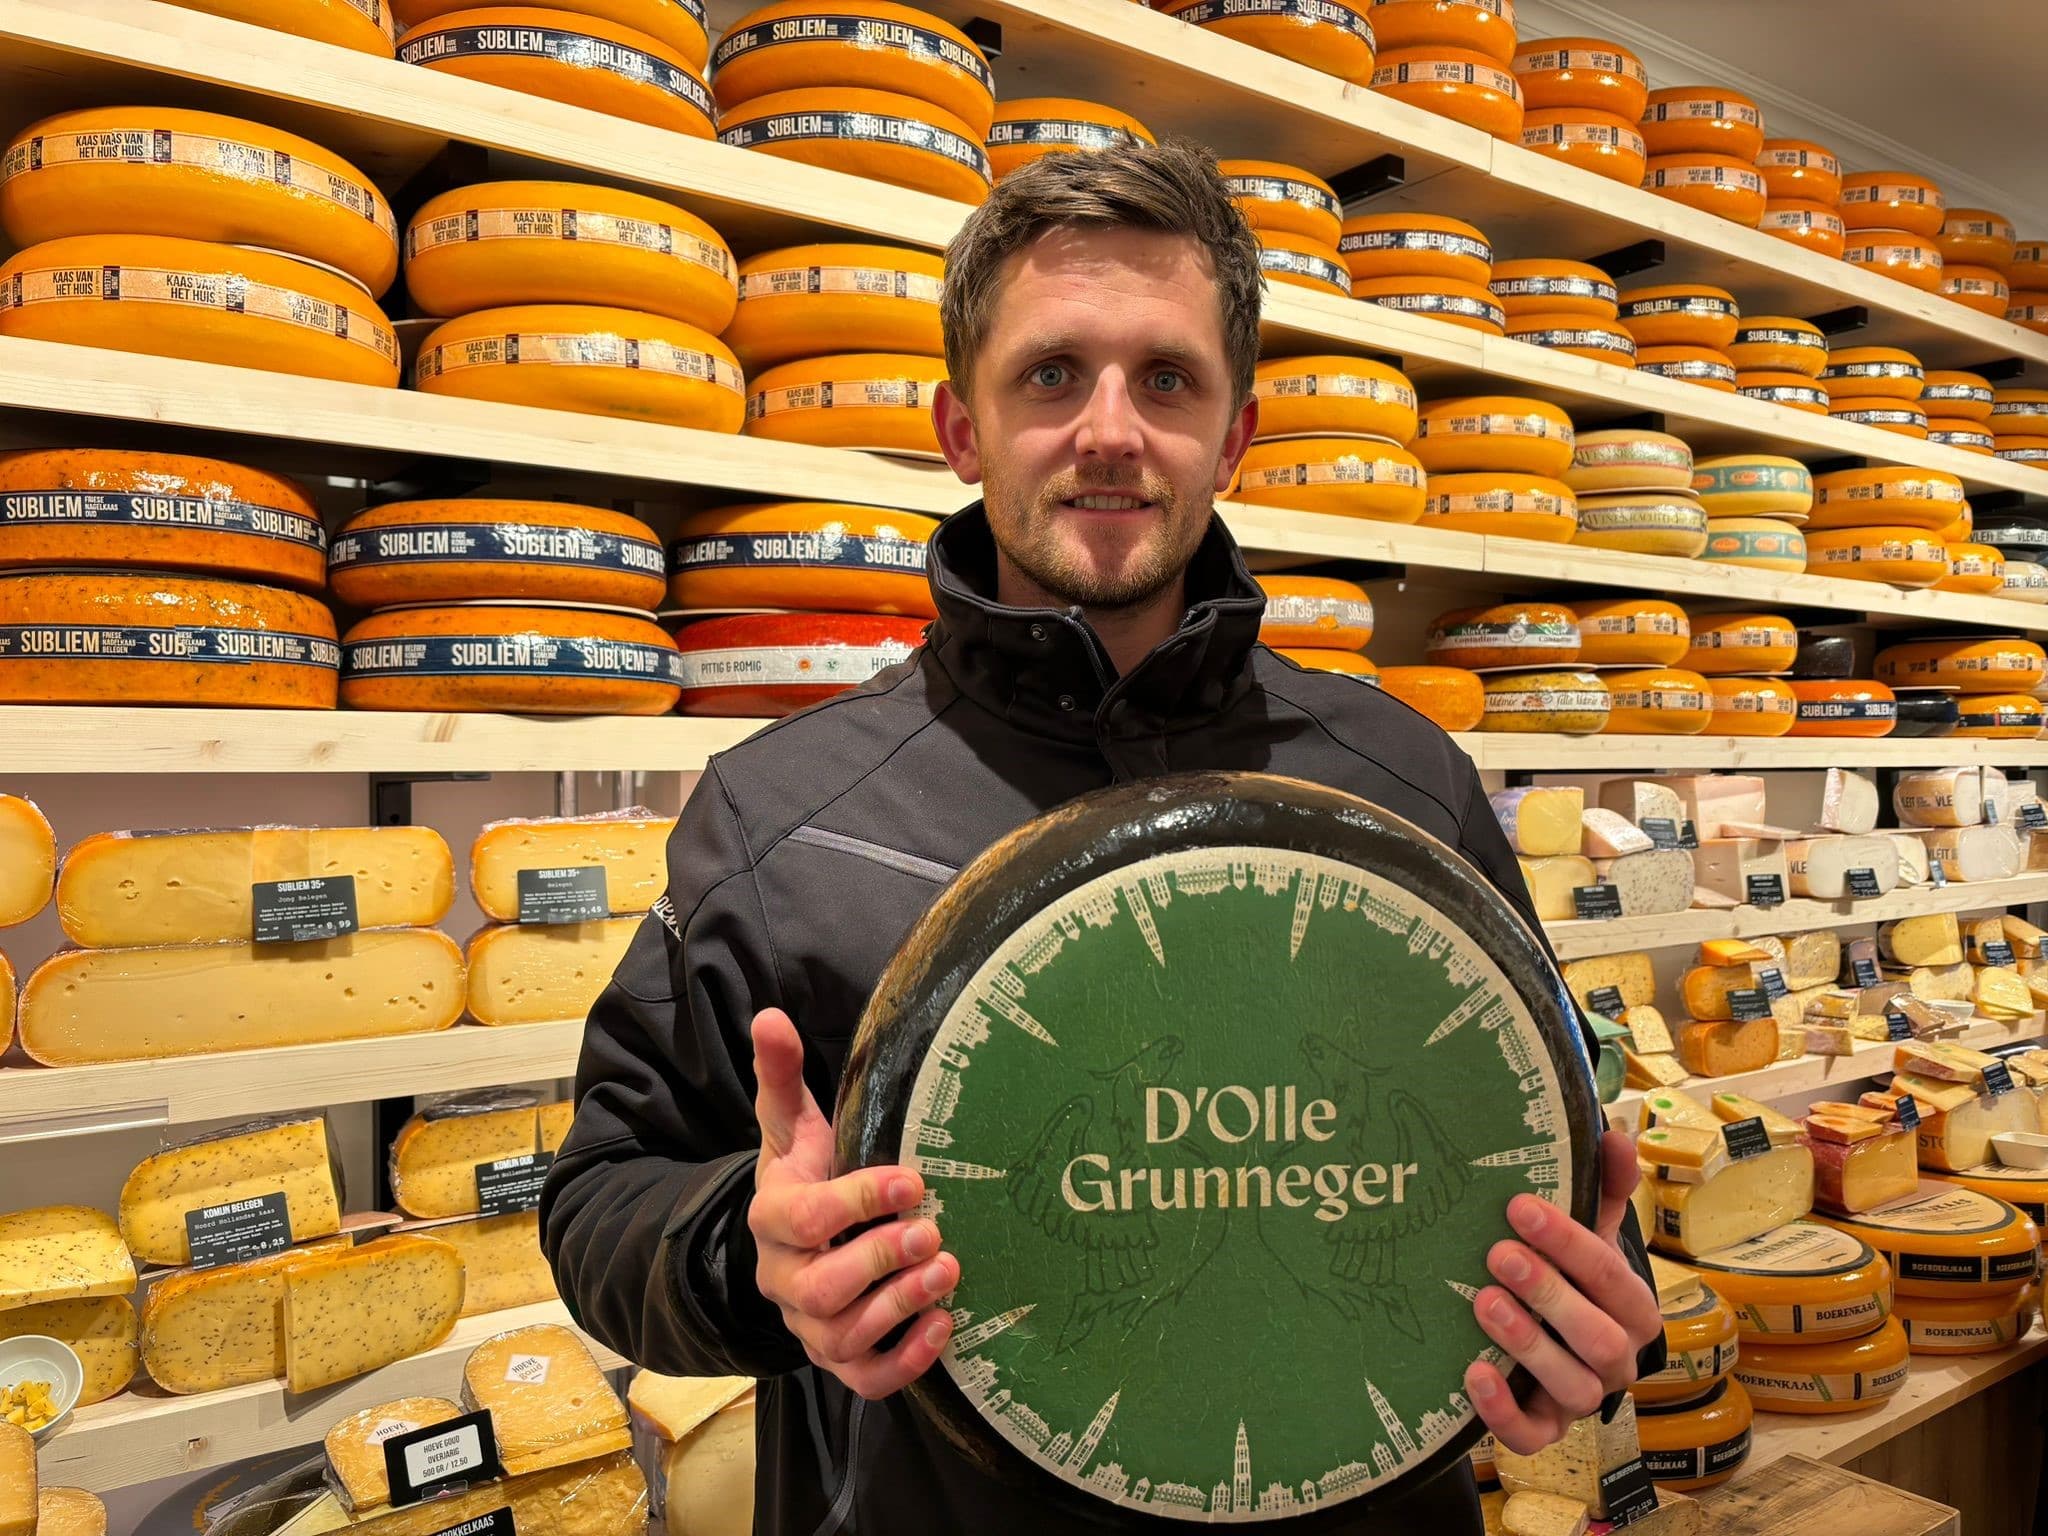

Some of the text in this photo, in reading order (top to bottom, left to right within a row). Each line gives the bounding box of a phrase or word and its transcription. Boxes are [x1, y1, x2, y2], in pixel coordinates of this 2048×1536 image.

[1297, 0, 1338, 21] SUBLIEM
[772, 20, 826, 40] SUBLIEM
[858, 20, 914, 44] SUBLIEM
[401, 35, 445, 63] SUBLIEM
[478, 31, 542, 52] SUBLIEM
[940, 40, 976, 72] SUBLIEM
[768, 116, 822, 138] SUBLIEM
[76, 133, 144, 147] KAAS VAN
[79, 145, 144, 158] HET HUIS HUIS
[246, 148, 265, 162] VAN
[934, 132, 973, 167] SUBLIEM
[328, 174, 360, 197] KAAS VAN
[332, 188, 360, 210] HET HUIS
[432, 216, 460, 233] KAAS VAN
[513, 212, 553, 224] KAAS VAN
[517, 224, 553, 234] HET HUIS
[616, 220, 636, 232] KAAS
[435, 228, 460, 243] HET HUIS
[619, 231, 634, 242] HET
[1341, 234, 1382, 250] SUBLIEM
[52, 270, 94, 284] KAAS VAN
[166, 274, 193, 288] KAAS
[771, 272, 800, 282] KAAS VAN
[874, 273, 888, 282] VAN
[56, 282, 94, 296] HET HUIS
[773, 282, 800, 292] HET HUIS
[1490, 280, 1528, 295] SUBLIEM
[170, 288, 216, 304] HET HUIS
[1378, 296, 1420, 310] SUBLIEM
[313, 300, 328, 314] VAN
[1633, 300, 1672, 316] SUBLIEM
[292, 308, 328, 328] HET HUIS
[1553, 331, 1592, 345] SUBLIEM
[1748, 330, 1782, 342] SUBLIEM
[466, 340, 498, 353] KAAS VAN
[468, 350, 498, 363] HET HUIS
[672, 350, 688, 364] KAAS
[1274, 378, 1301, 387] KAAS VAN
[786, 388, 814, 400] KAAS VAN
[1276, 386, 1288, 395] HET
[789, 396, 814, 408] HET HUIS
[6, 496, 82, 519] SUBLIEM
[84, 504, 118, 512] NAGELKAAS
[132, 497, 212, 525] SUBLIEM
[252, 510, 303, 540] SUBLIEM
[380, 532, 449, 556] SUBLIEM
[452, 545, 468, 554] KAAS
[504, 534, 580, 560] SUBLIEM
[753, 538, 820, 560] SUBLIEM
[622, 543, 661, 572] SUBLIEM
[864, 543, 924, 568] SUBLIEM
[20, 631, 100, 653] SUBLIEM
[102, 632, 122, 640] FRIESE
[102, 639, 136, 647] NAGELKAAS
[218, 632, 284, 656] SUBLIEM
[353, 646, 402, 670] SUBLIEM
[452, 642, 530, 668] SUBLIEM
[584, 646, 644, 672] SUBLIEM
[701, 660, 762, 674] PITTIG & ROMIG
[1802, 704, 1842, 716] SUBLIEM
[538, 870, 567, 879] SUBLIEM
[1790, 860, 1808, 874] VLE
[278, 880, 325, 892] SUBLIEM 35+
[278, 895, 296, 904] Jong
[580, 906, 602, 914] 9,49
[1146, 1084, 1337, 1144] D'Olle
[1061, 1153, 1418, 1223] Grunneger
[231, 1198, 264, 1214] BELEGEN
[194, 1221, 216, 1230] Noord
[218, 1213, 256, 1224] Hollandse
[1912, 1263, 1972, 1273] BOERDERIJKAAS
[1816, 1302, 1876, 1321] BOERENKAAS
[1925, 1326, 1993, 1337] BOERENKAAS
[512, 1356, 538, 1374] HOEVE
[1734, 1373, 1816, 1392] BOERENKAAS
[376, 1422, 406, 1437] HOEVE
[423, 1438, 443, 1454] HOEVE
[428, 1448, 460, 1464] OVERJARIG
[422, 1467, 436, 1478] 500
[436, 1464, 446, 1475] GR
